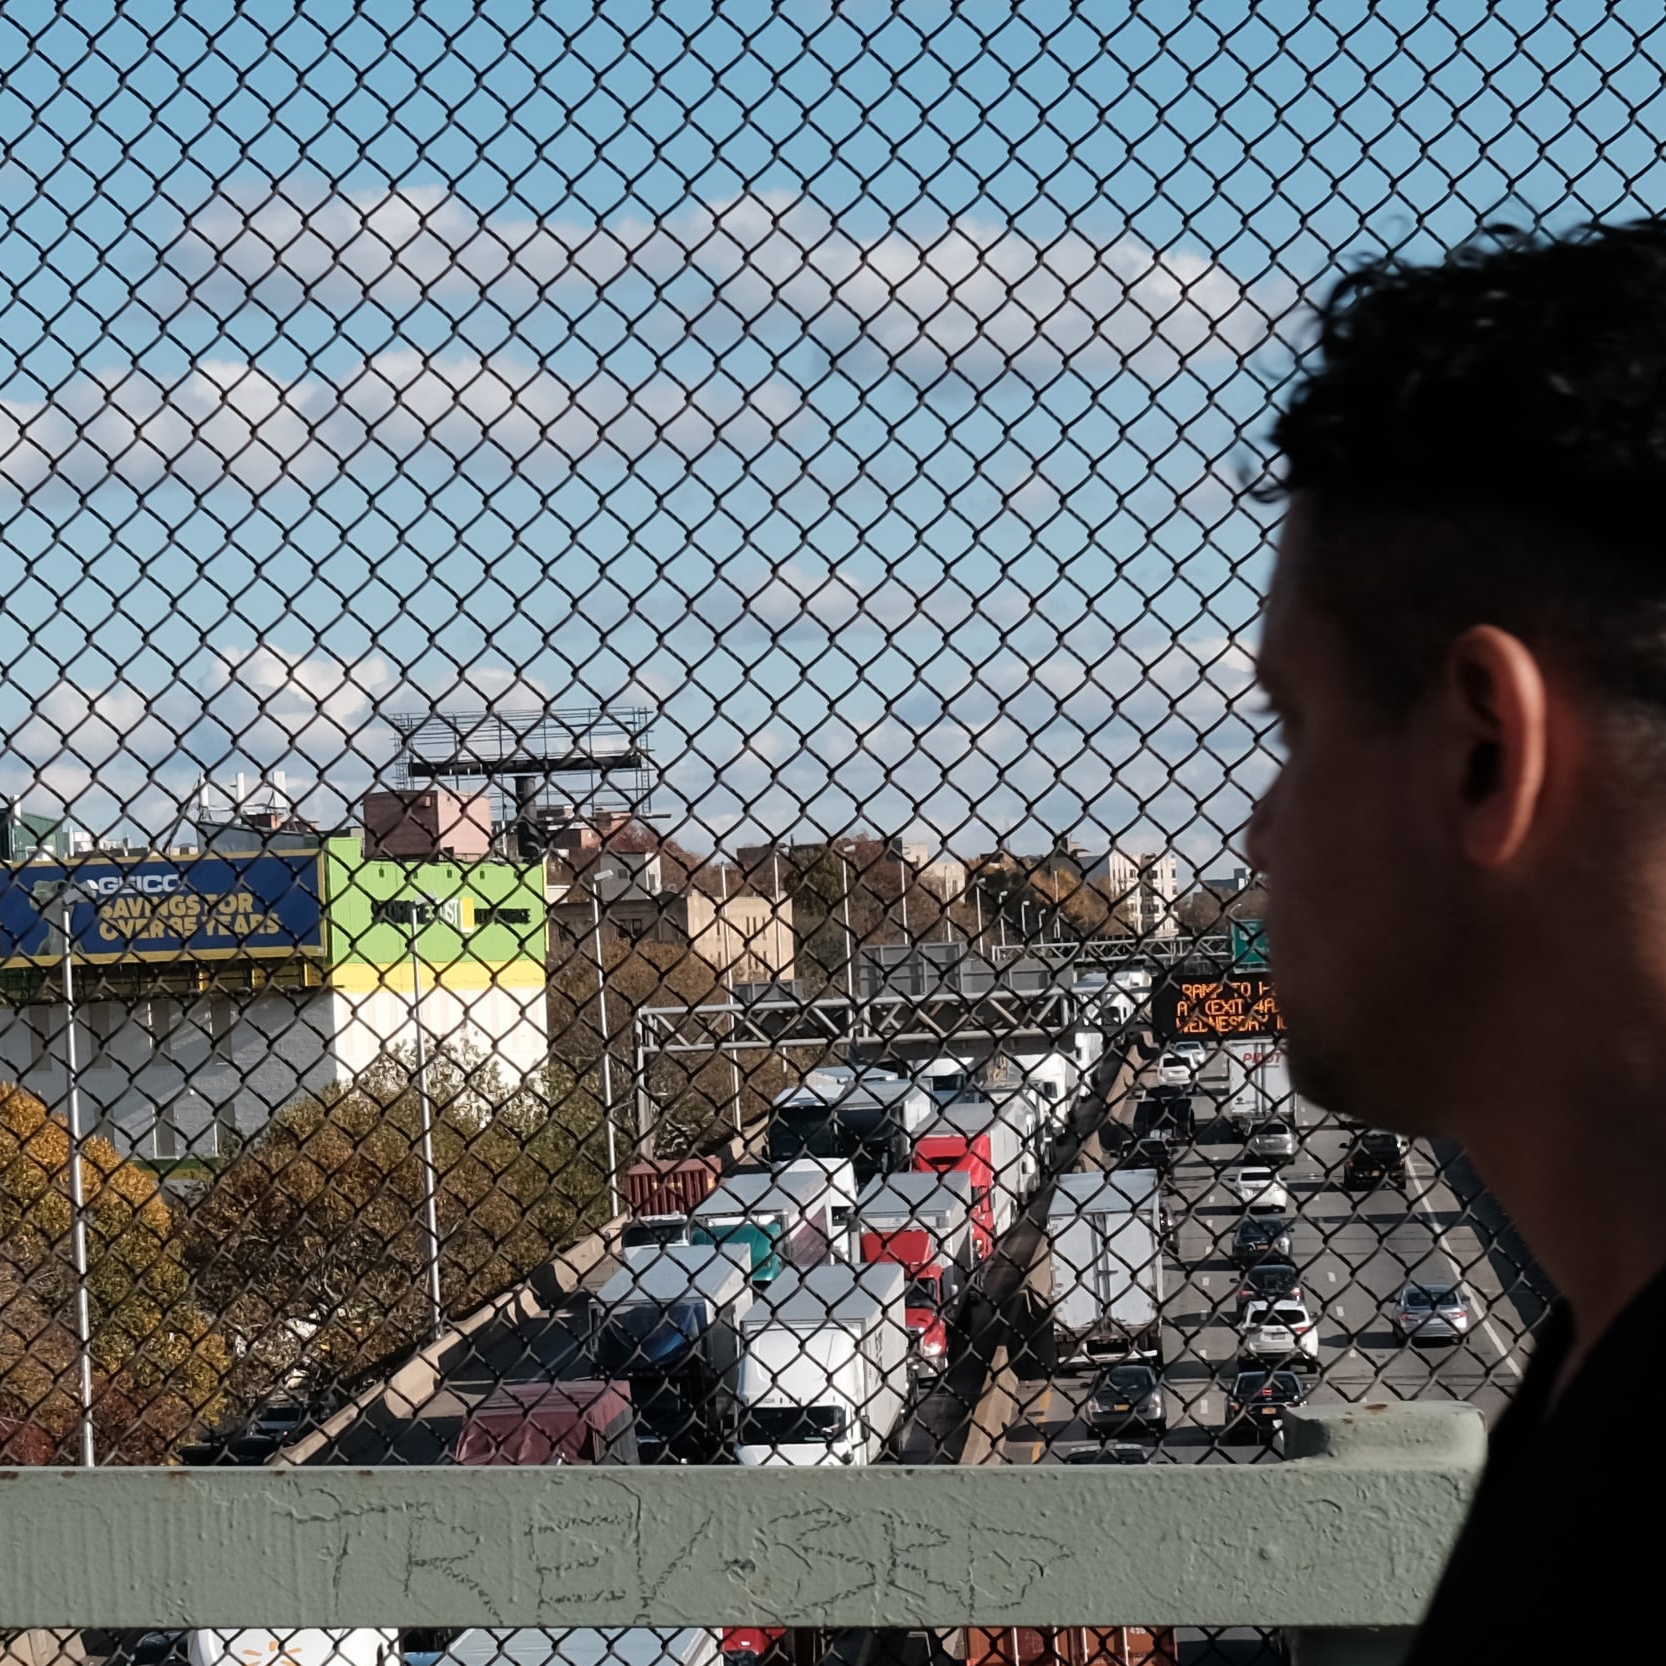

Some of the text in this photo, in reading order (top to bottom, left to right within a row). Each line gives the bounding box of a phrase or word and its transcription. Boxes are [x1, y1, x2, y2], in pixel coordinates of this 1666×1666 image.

[98, 874, 184, 895] GEICO
[98, 892, 253, 918] SAVINGS FOR
[99, 917, 165, 941] OVER
[202, 913, 280, 937] YEARS
[1182, 982, 1223, 1000] RAMP
